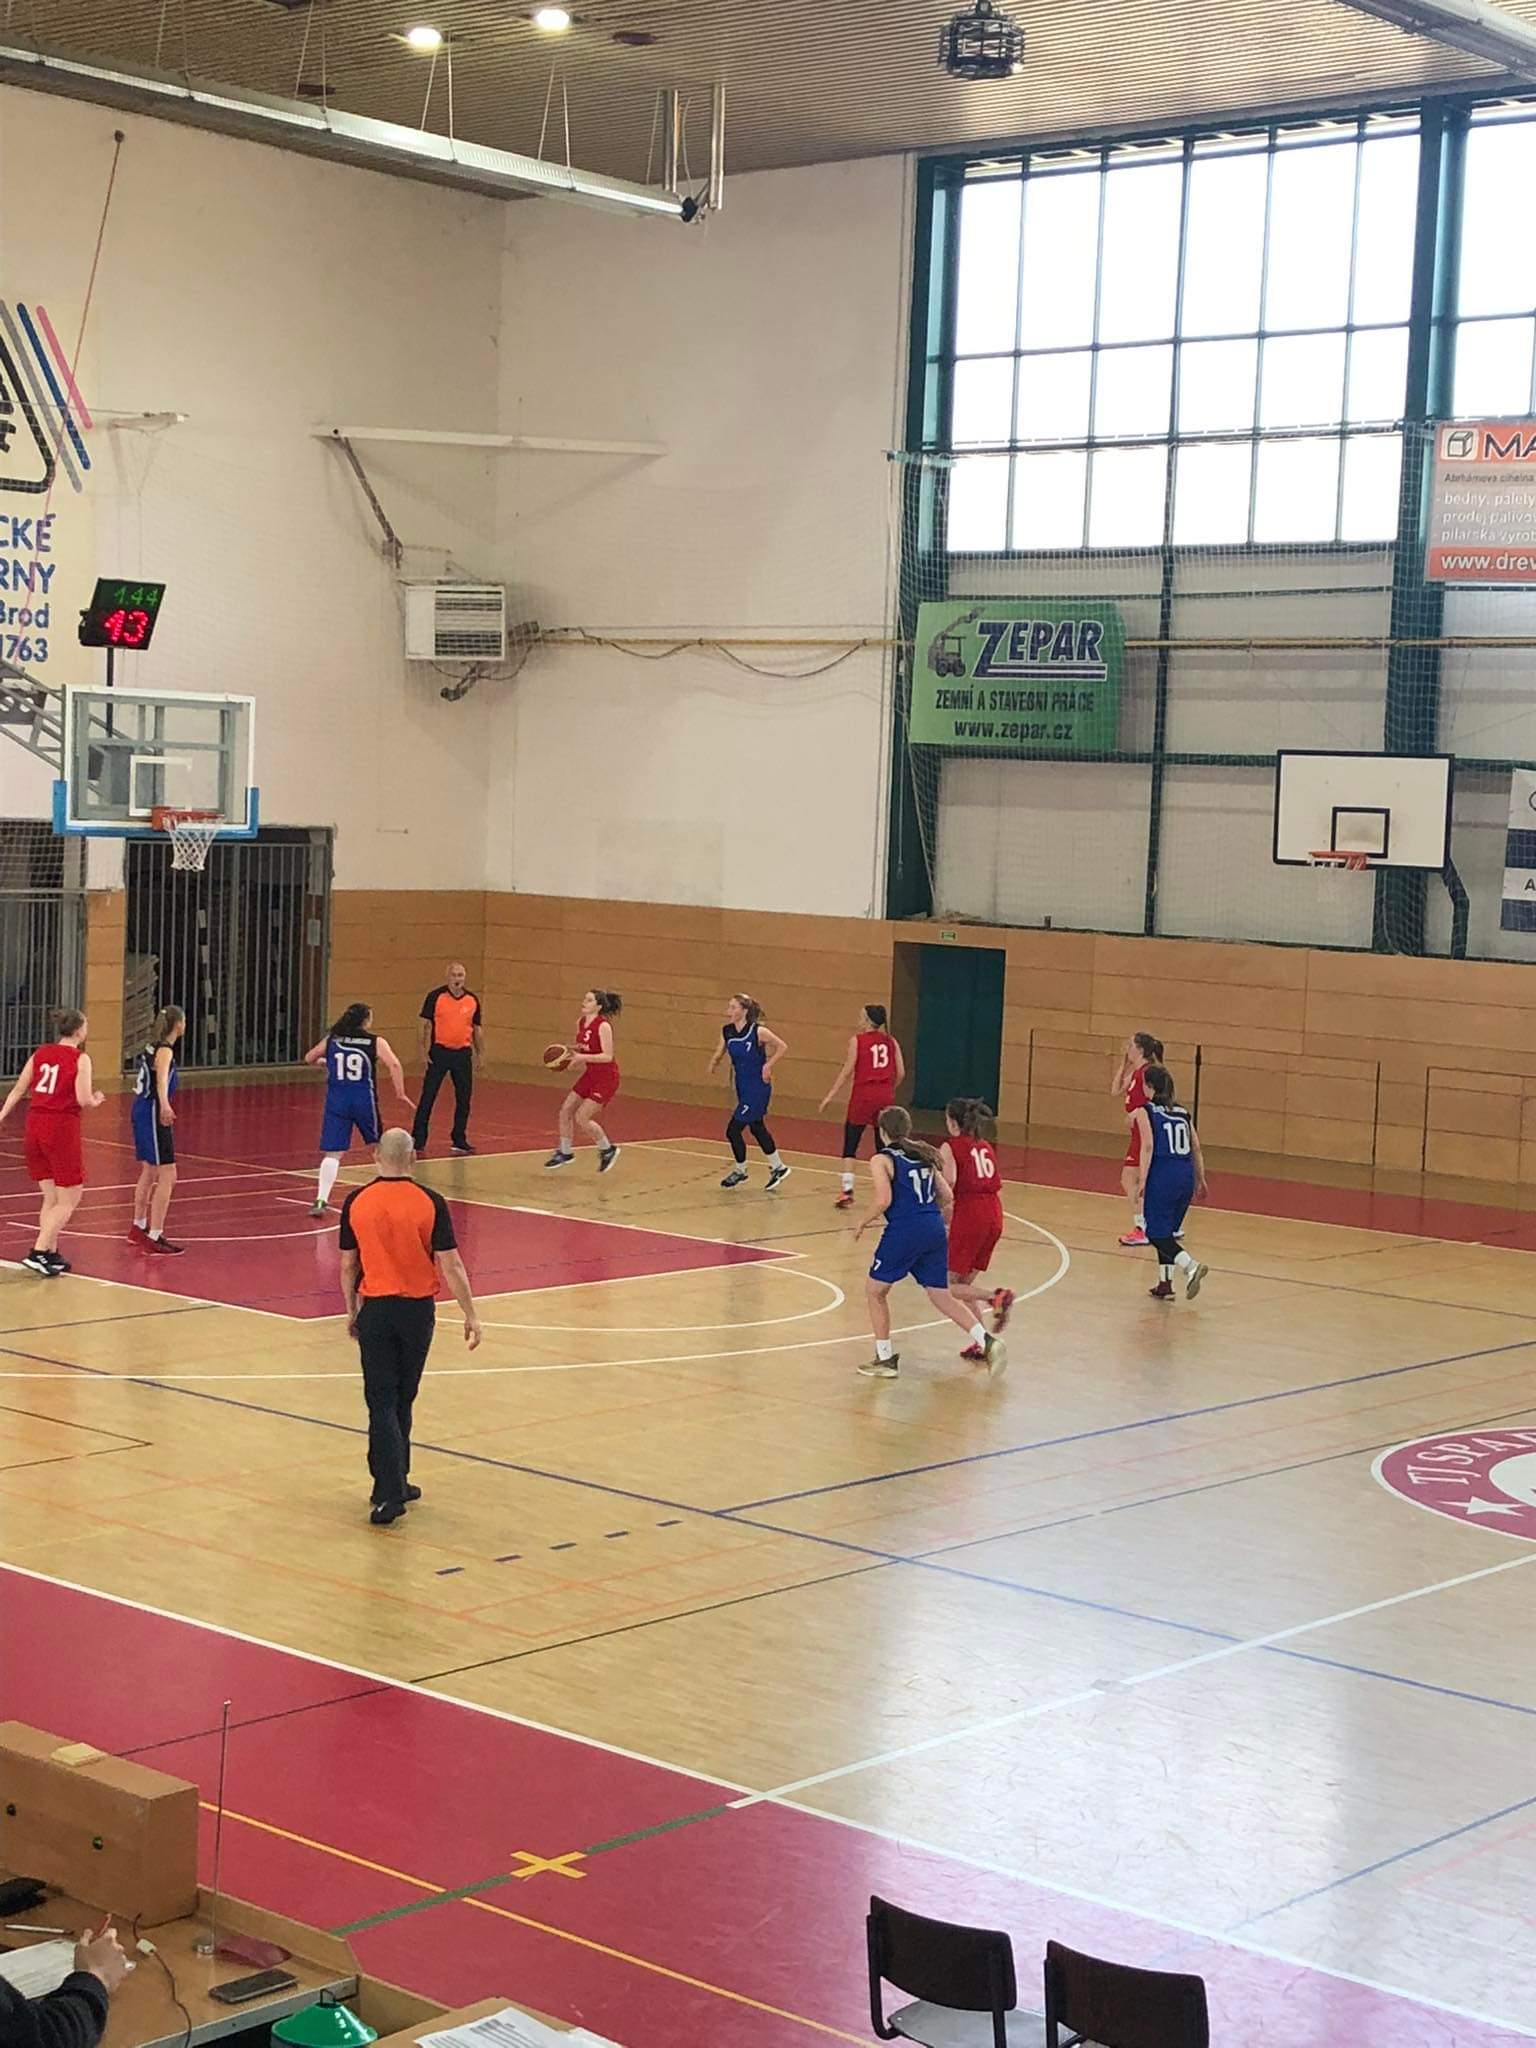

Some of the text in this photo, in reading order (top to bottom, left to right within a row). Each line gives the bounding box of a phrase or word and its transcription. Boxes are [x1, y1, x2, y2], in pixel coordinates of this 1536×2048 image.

[971, 620, 1107, 681] ZEPAR
[935, 684, 974, 710] ZEMNÍ
[977, 689, 985, 711] A
[953, 720, 1074, 742] www.zepar.cz
[745, 1041, 753, 1052] 7
[870, 1044, 889, 1069] 13
[35, 1063, 60, 1095] 21
[334, 1052, 363, 1081] 19
[740, 1104, 749, 1115] 7
[1163, 1121, 1191, 1156] 10
[970, 1147, 994, 1179] 16
